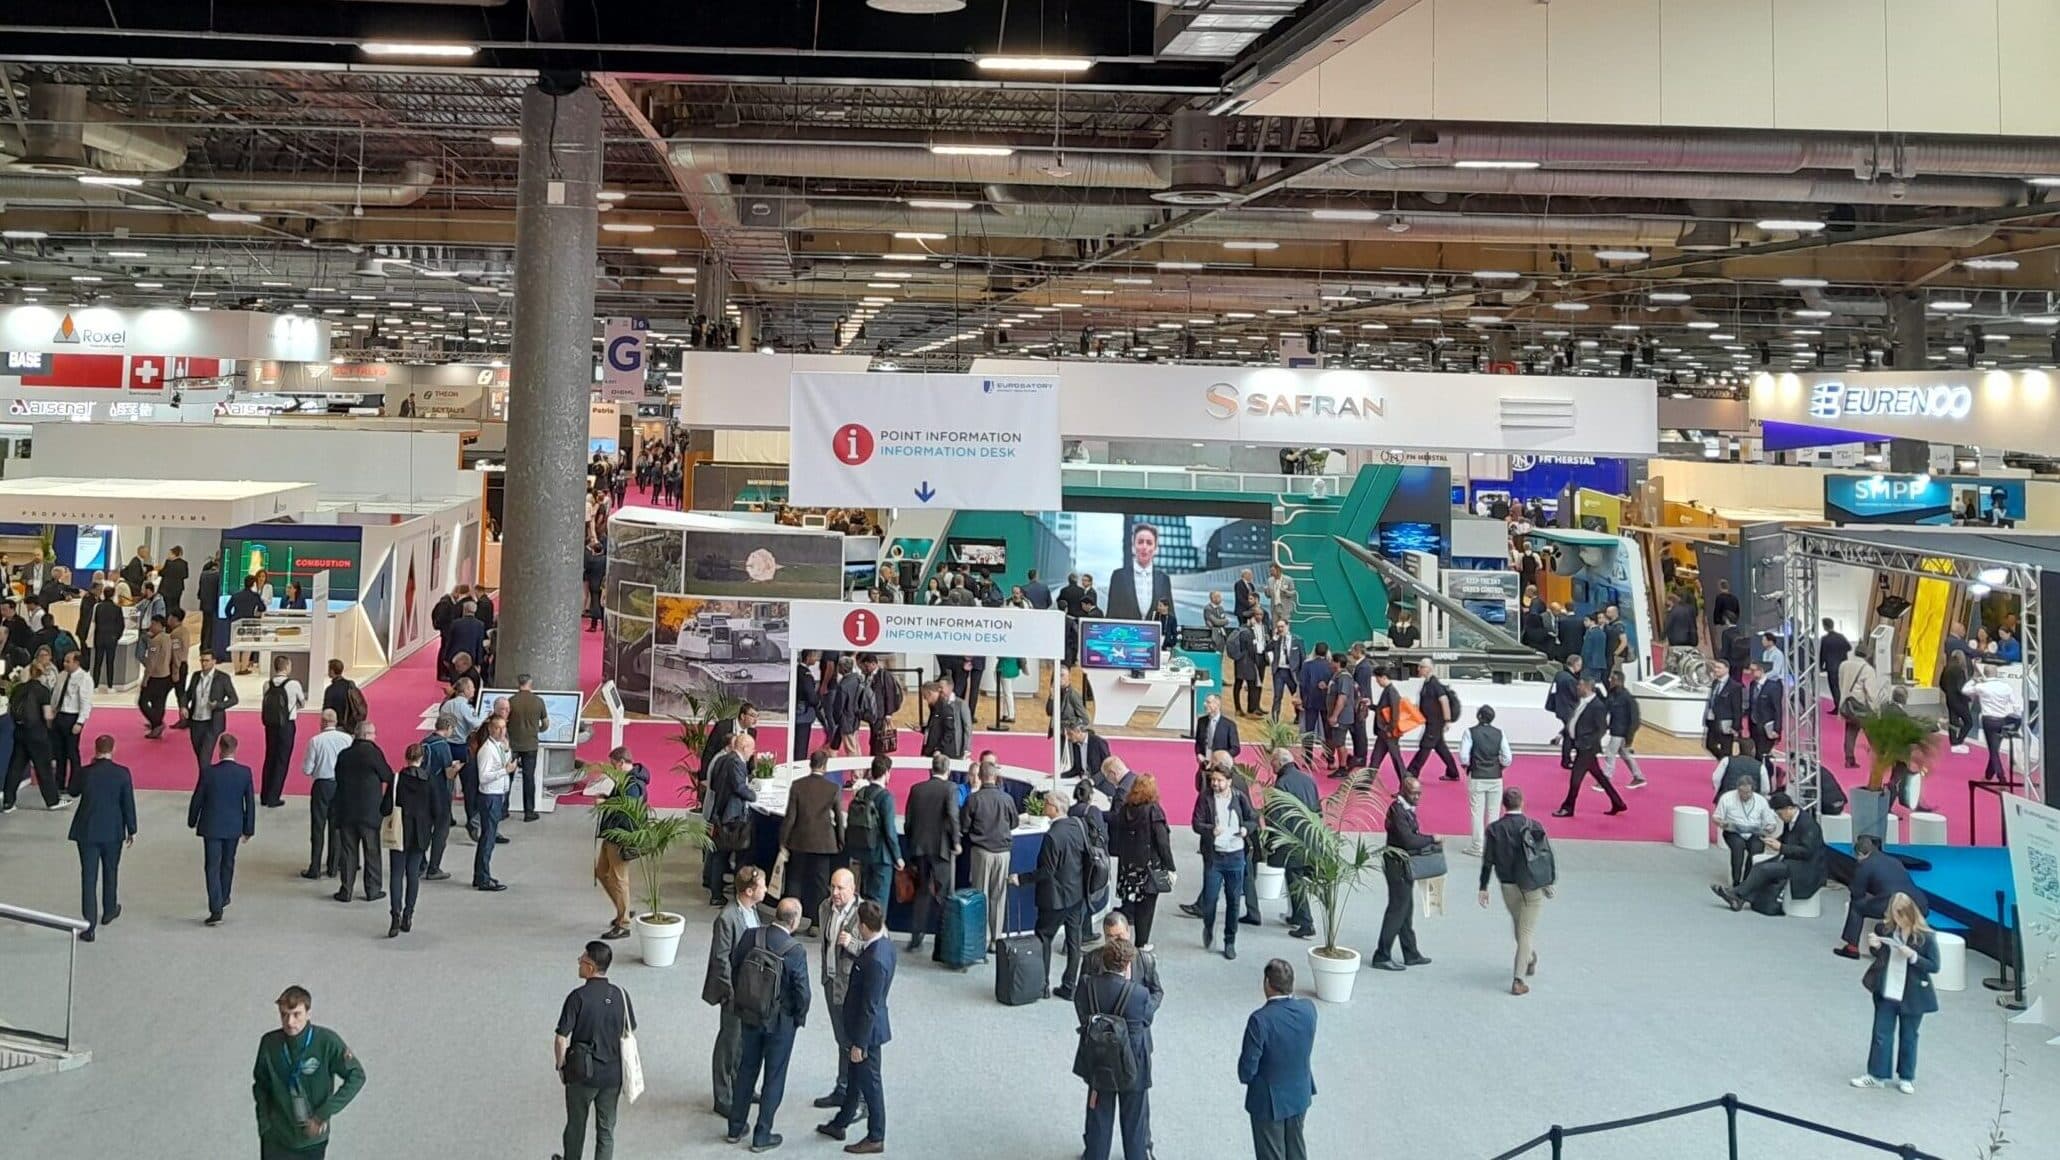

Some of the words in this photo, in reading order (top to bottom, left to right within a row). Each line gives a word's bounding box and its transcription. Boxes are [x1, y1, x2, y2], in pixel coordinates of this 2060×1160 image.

[83, 329, 126, 343] Roxel
[8, 351, 42, 368] BASE
[608, 335, 641, 372] G
[1247, 393, 1385, 417] SAFRAN
[880, 430, 921, 441] POINT
[926, 430, 1022, 443] INFORMATION
[880, 445, 977, 457] INFORMATION
[980, 447, 1016, 458] DESK
[1538, 455, 1552, 464] FN
[1555, 456, 1596, 465] HERSTAL
[1855, 479, 1924, 500] SMPP
[295, 558, 351, 568] COMBUSTION
[886, 616, 922, 627] POINT
[926, 617, 1013, 630] INFORMATION
[885, 630, 972, 642] INFORMATION
[975, 633, 1008, 643] DESK
